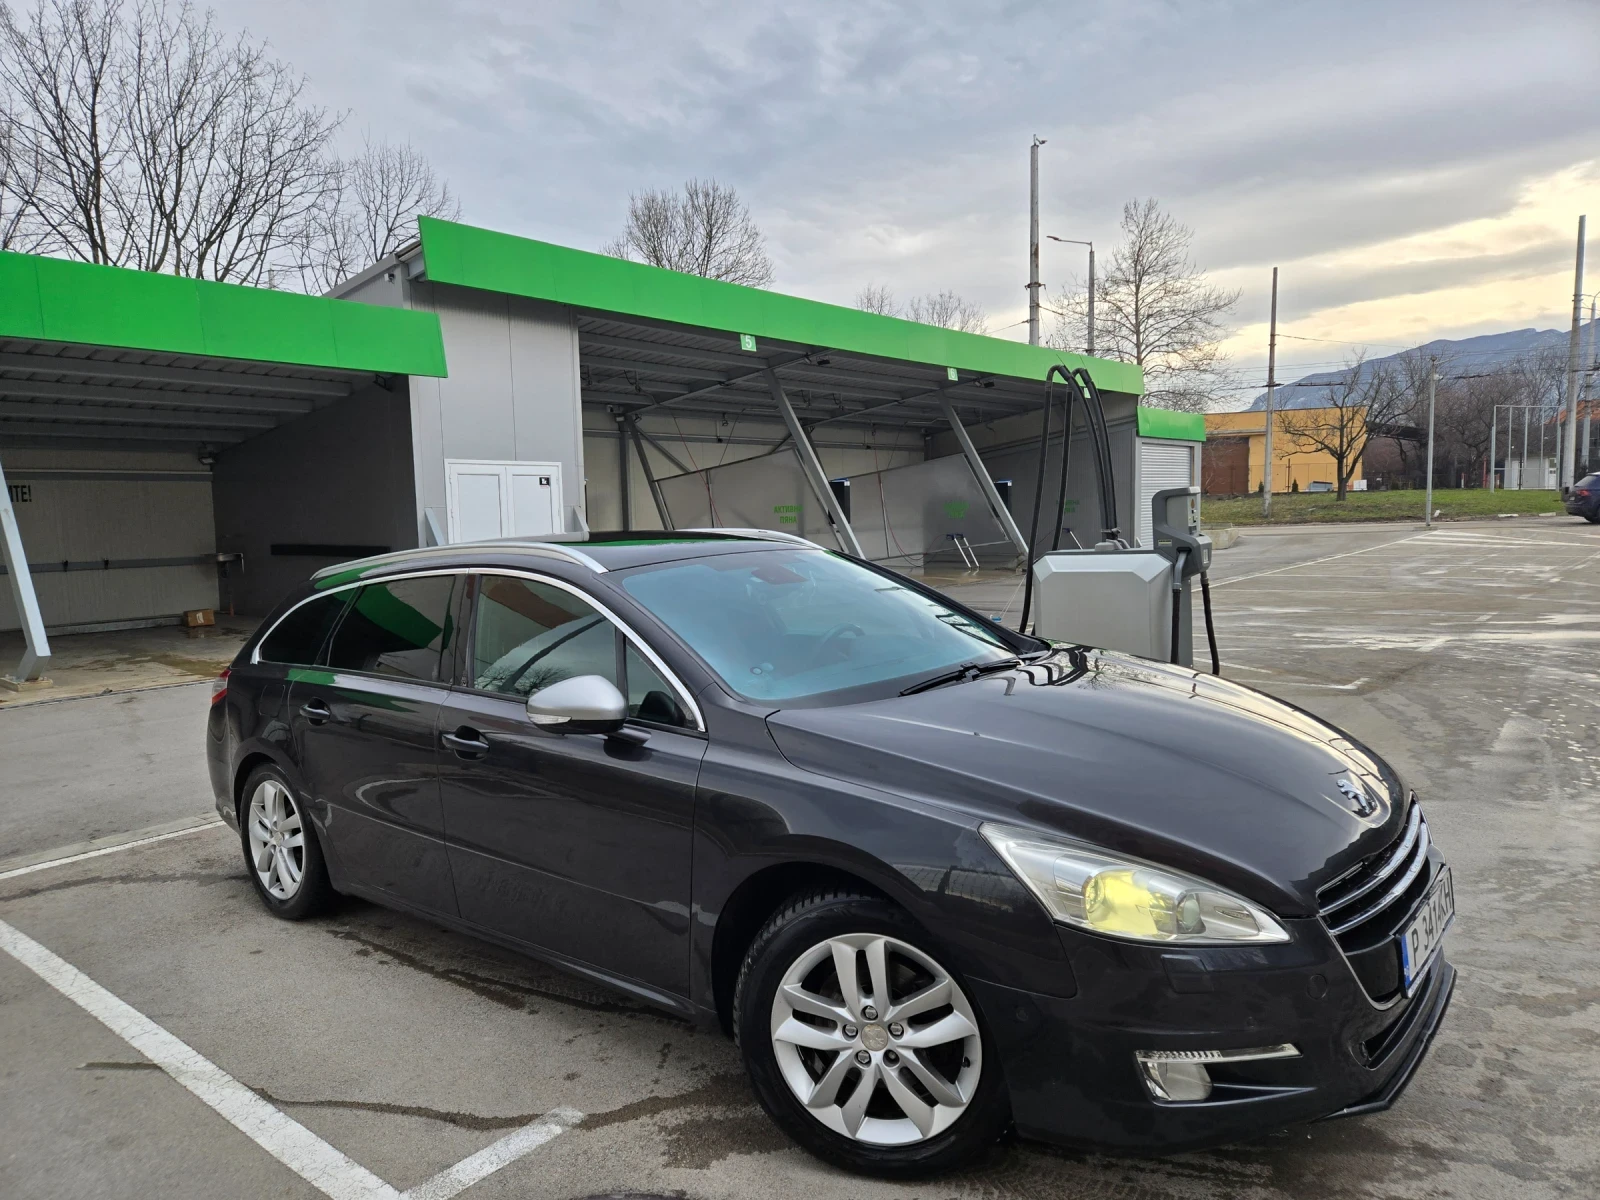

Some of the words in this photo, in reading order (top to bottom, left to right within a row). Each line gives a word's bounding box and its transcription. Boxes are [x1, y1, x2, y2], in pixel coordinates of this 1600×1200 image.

[745, 335, 752, 348] 5
[950, 368, 955, 379] 6
[780, 516, 797, 524] ПЯНА
[1411, 928, 1419, 968] P
